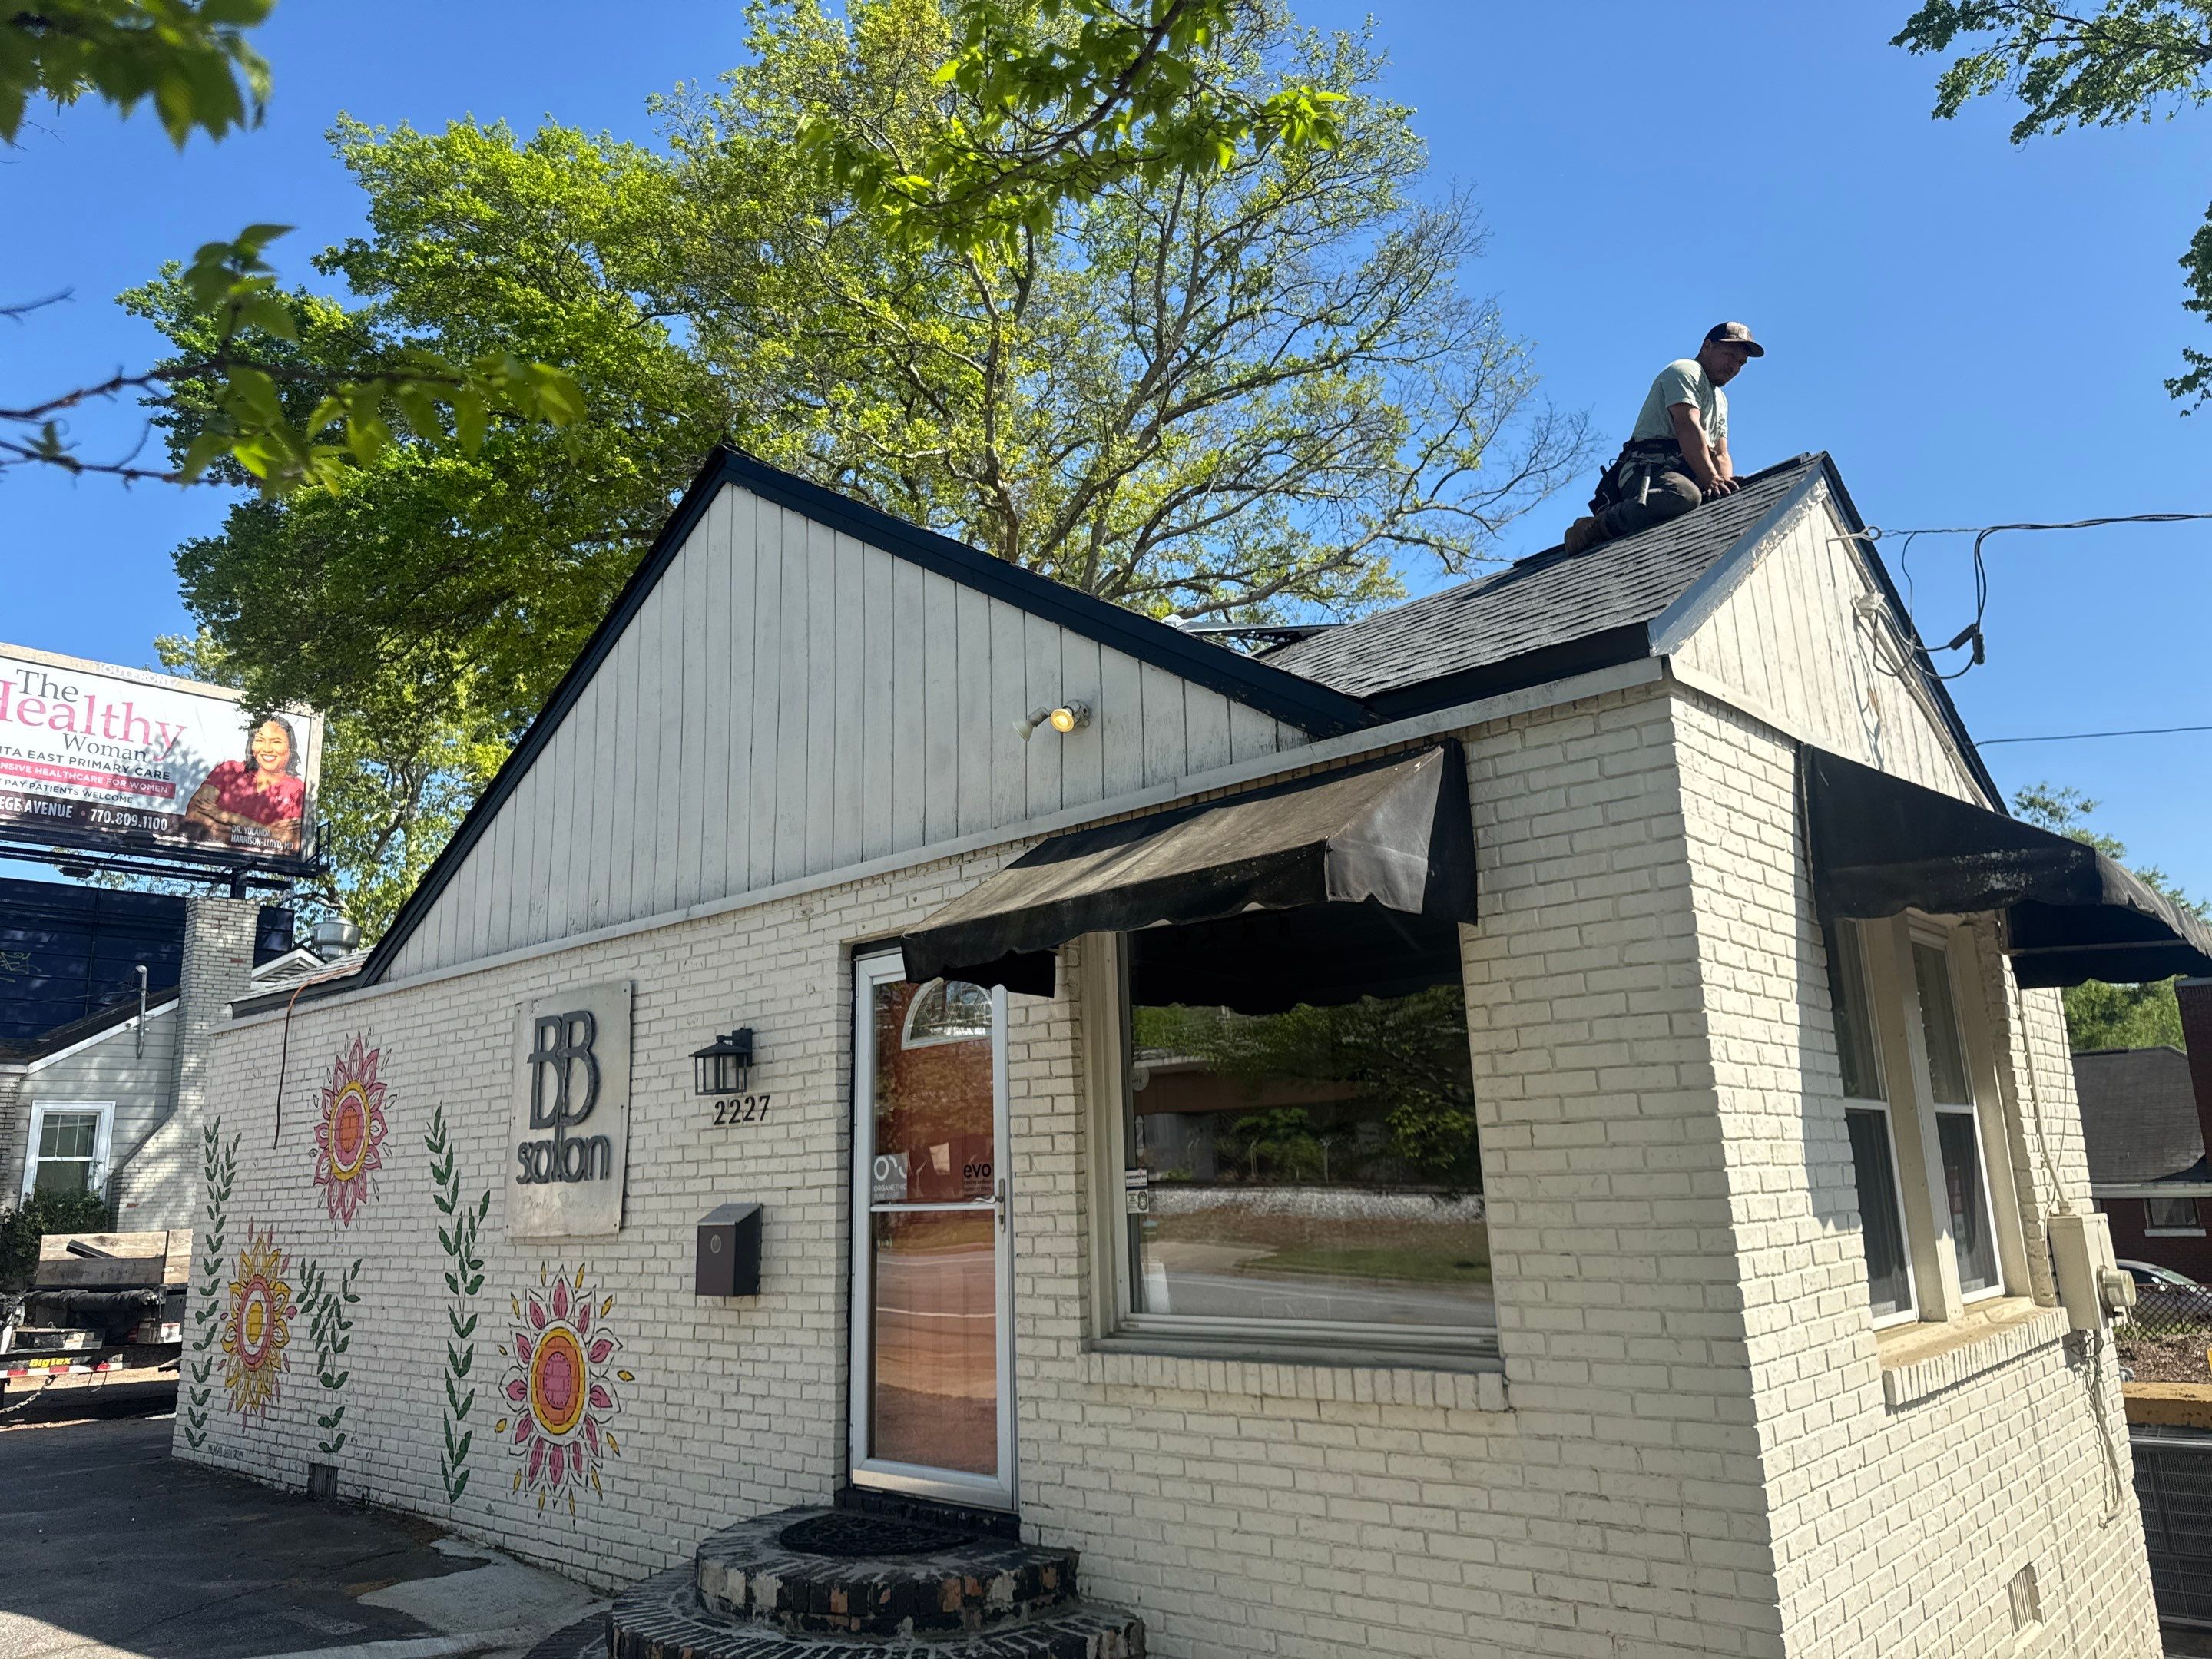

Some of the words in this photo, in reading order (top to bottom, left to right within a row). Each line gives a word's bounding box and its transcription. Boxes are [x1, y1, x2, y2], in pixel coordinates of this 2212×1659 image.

[16, 668, 78, 703] The
[63, 733, 147, 763] Woman
[28, 750, 64, 763] EAST
[69, 757, 130, 773] PRIMARY
[134, 767, 171, 780] CARE
[35, 767, 103, 783] HEALTHCARE
[106, 778, 127, 787] FOR
[130, 781, 167, 793] WOMEN
[5, 779, 26, 788] PAY
[29, 783, 79, 796] PATIENTS
[82, 790, 133, 803] WELCOME
[0, 796, 22, 812] EGE
[24, 800, 73, 819] AVENUE
[91, 809, 168, 831] 770.809.1100
[232, 825, 243, 833] DR.
[244, 826, 270, 838] YULANDA
[526, 1010, 601, 1130] BB
[714, 1095, 770, 1126] 2227
[516, 1115, 611, 1184] salon
[964, 1164, 992, 1178] evo
